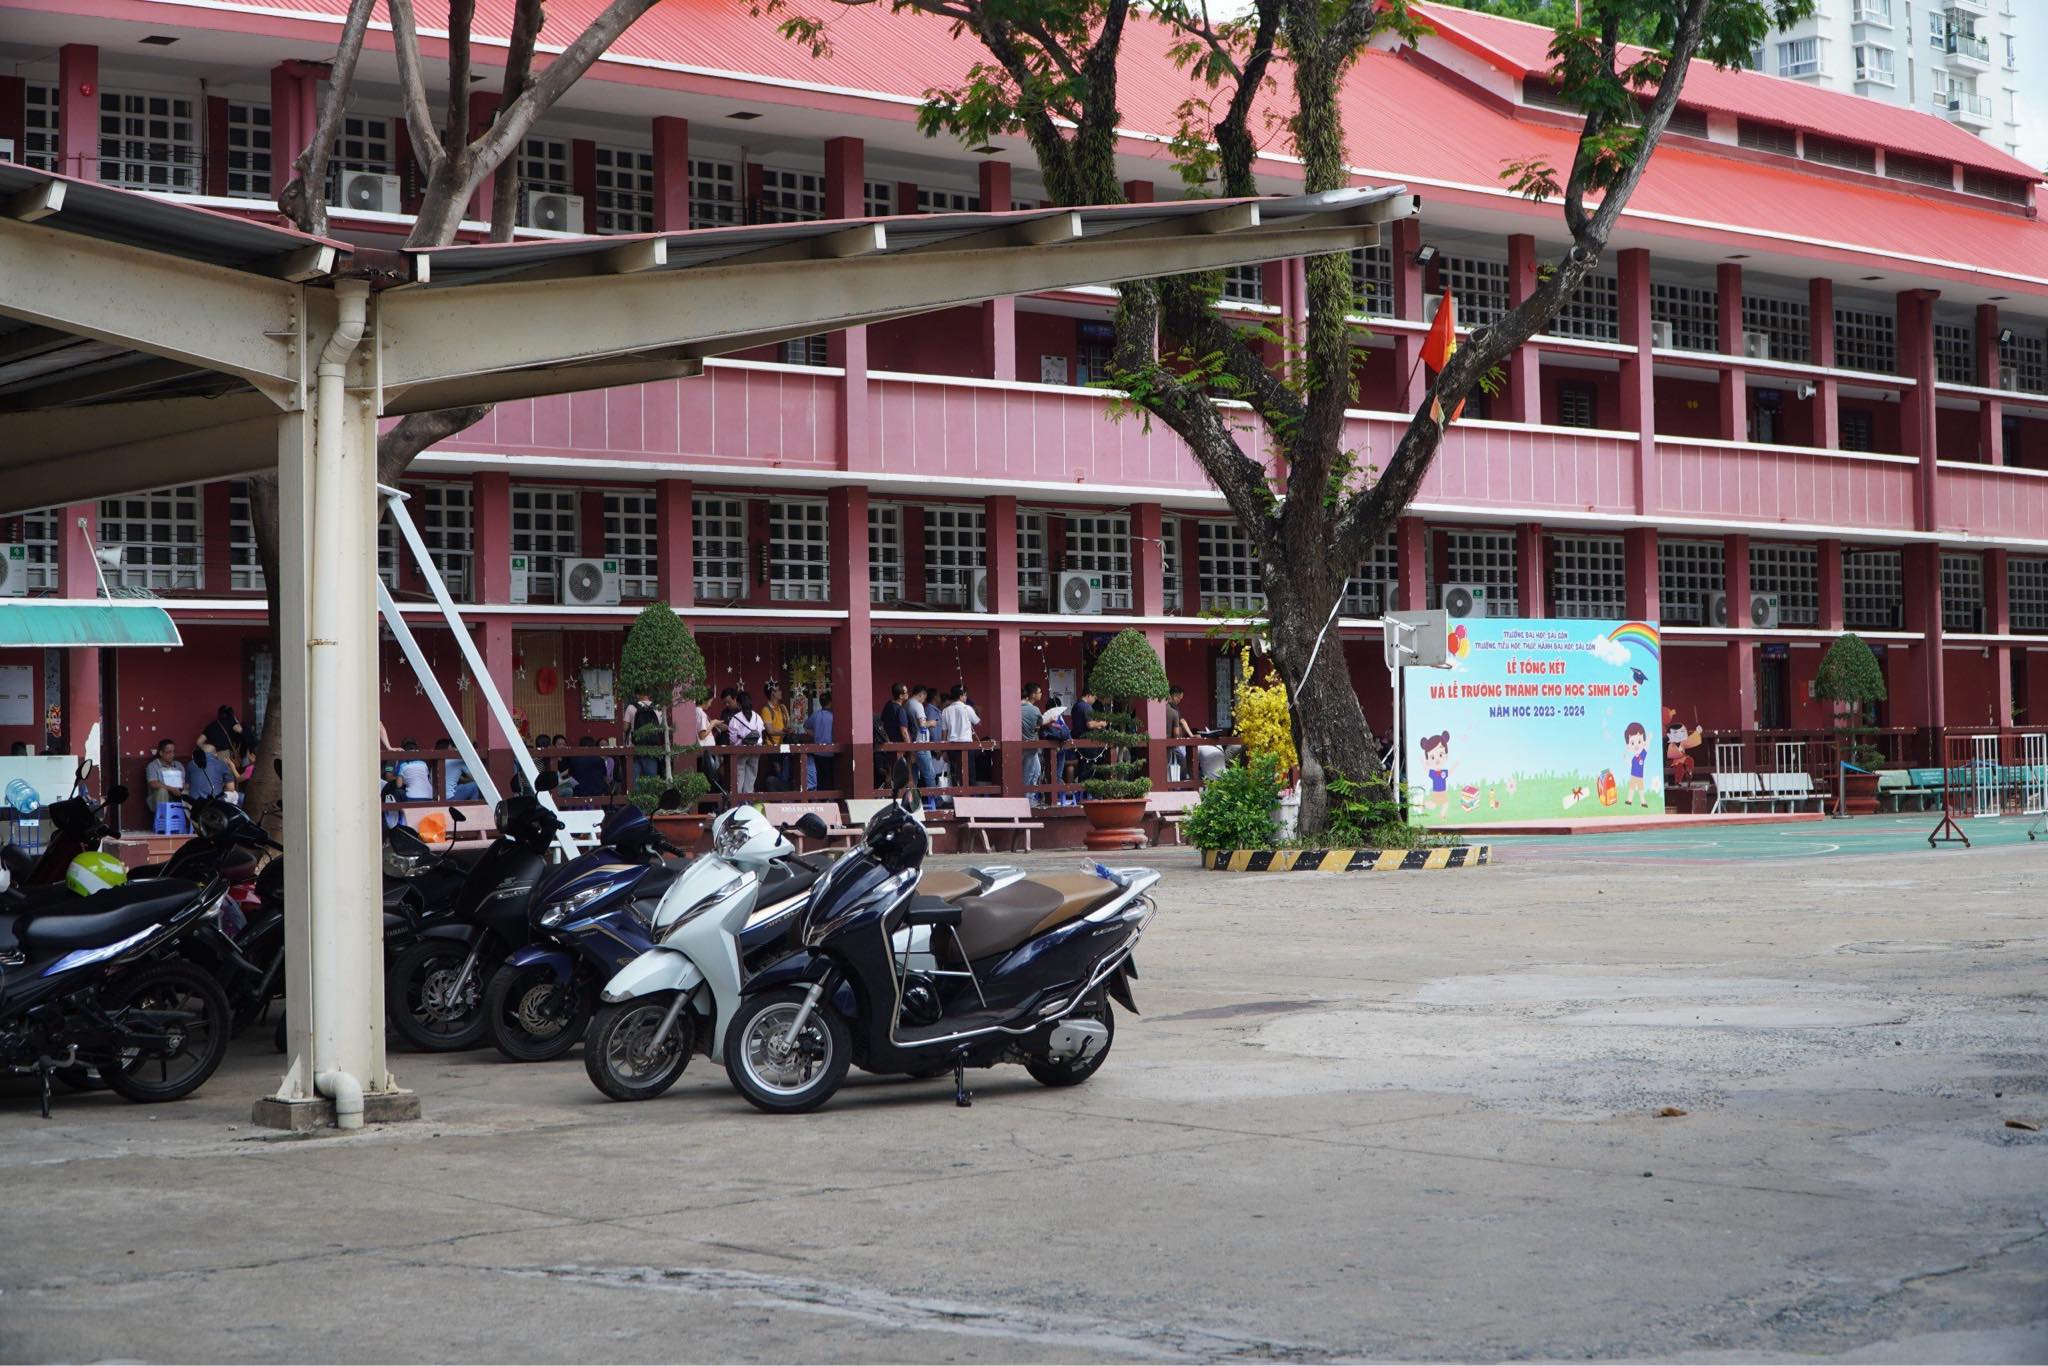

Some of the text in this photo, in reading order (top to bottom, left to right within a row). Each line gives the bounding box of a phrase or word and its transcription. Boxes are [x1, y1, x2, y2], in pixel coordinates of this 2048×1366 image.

[1506, 656, 1516, 674] LỄ
[1548, 658, 1566, 674] KẾT
[1430, 683, 1445, 699] VÀ
[1448, 680, 1458, 698] LỄ
[1541, 684, 1562, 697] CHO
[1564, 684, 1584, 700] HỌC
[1588, 684, 1610, 697] SINH
[1612, 682, 1630, 697] LỚP
[1632, 684, 1638, 697] 5
[1533, 706, 1555, 717] 2023
[1564, 706, 1585, 718] 2024
